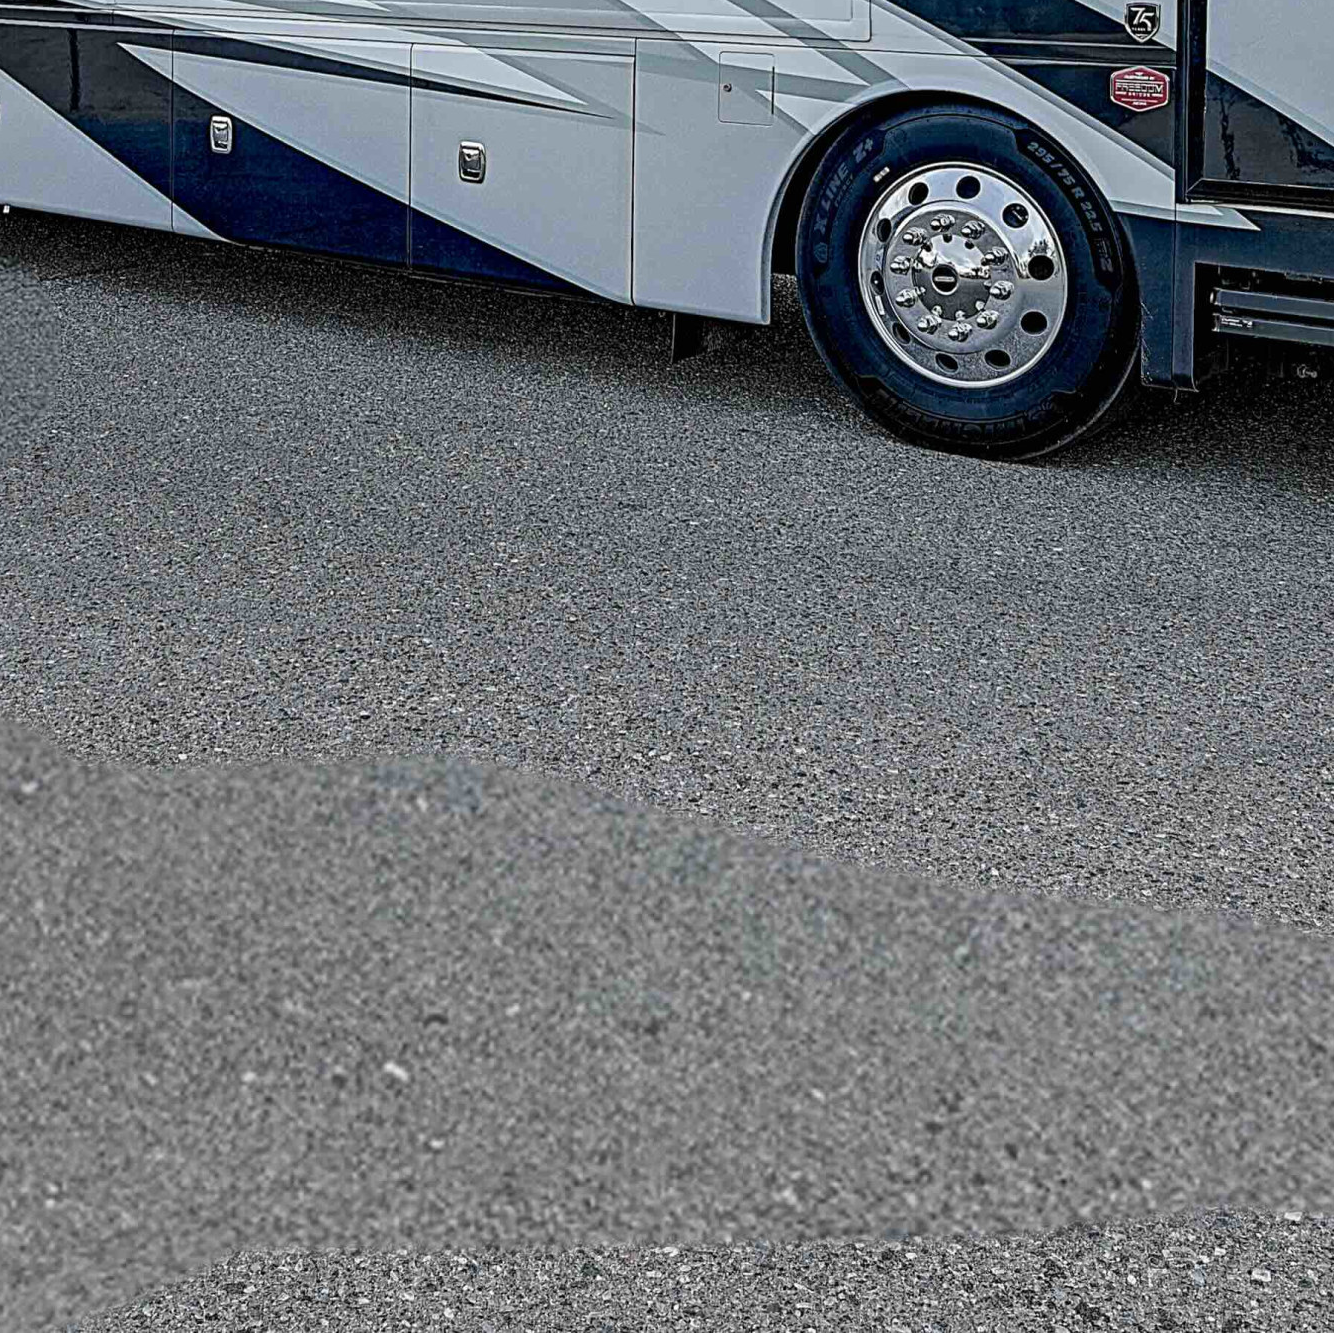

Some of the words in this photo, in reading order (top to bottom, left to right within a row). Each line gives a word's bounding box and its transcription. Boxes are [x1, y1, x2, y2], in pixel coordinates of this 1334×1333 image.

[1130, 7, 1154, 31] 75
[1115, 82, 1164, 93] FREEDOM
[820, 162, 850, 212] LINE
[813, 212, 828, 235] X
